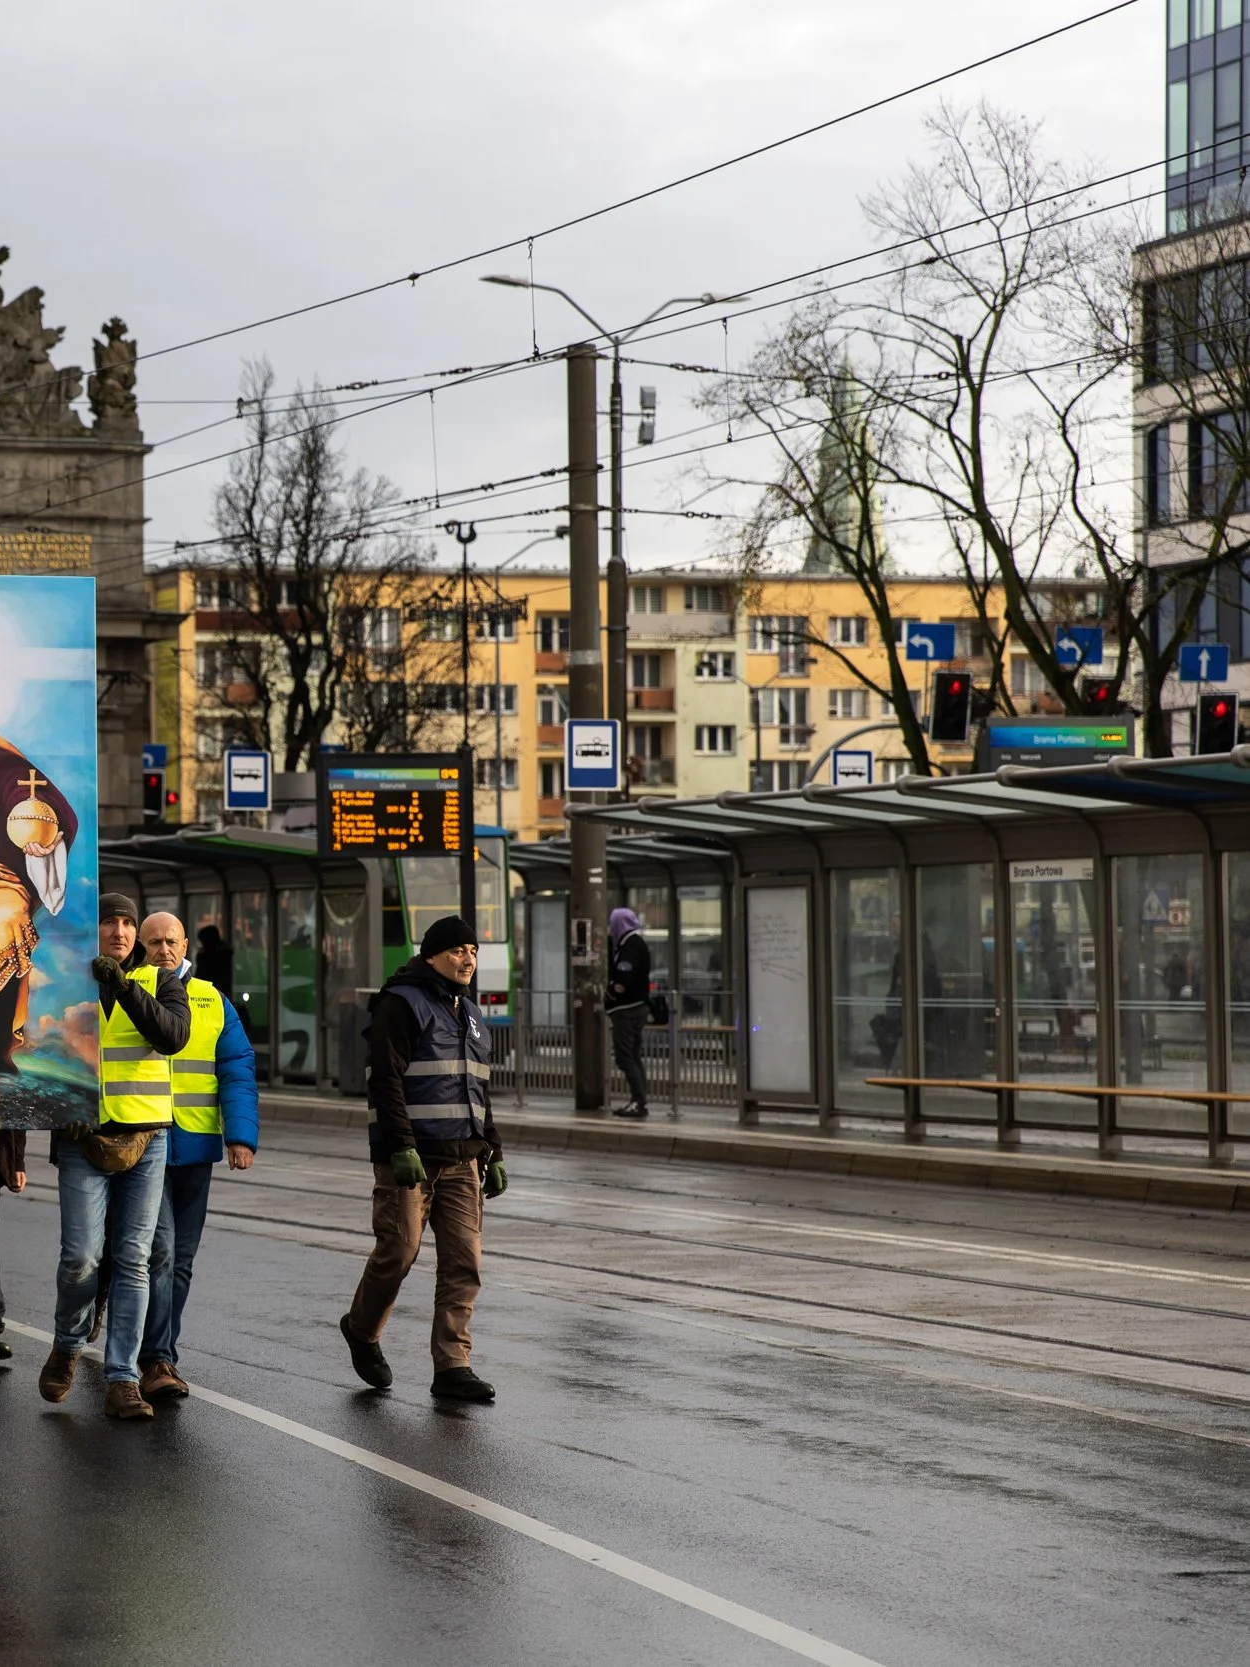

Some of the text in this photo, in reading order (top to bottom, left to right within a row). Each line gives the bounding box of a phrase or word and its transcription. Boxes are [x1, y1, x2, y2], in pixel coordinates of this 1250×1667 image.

[1033, 734, 1086, 744] Brama Portowa
[1013, 865, 1063, 878] Brama Portowa
